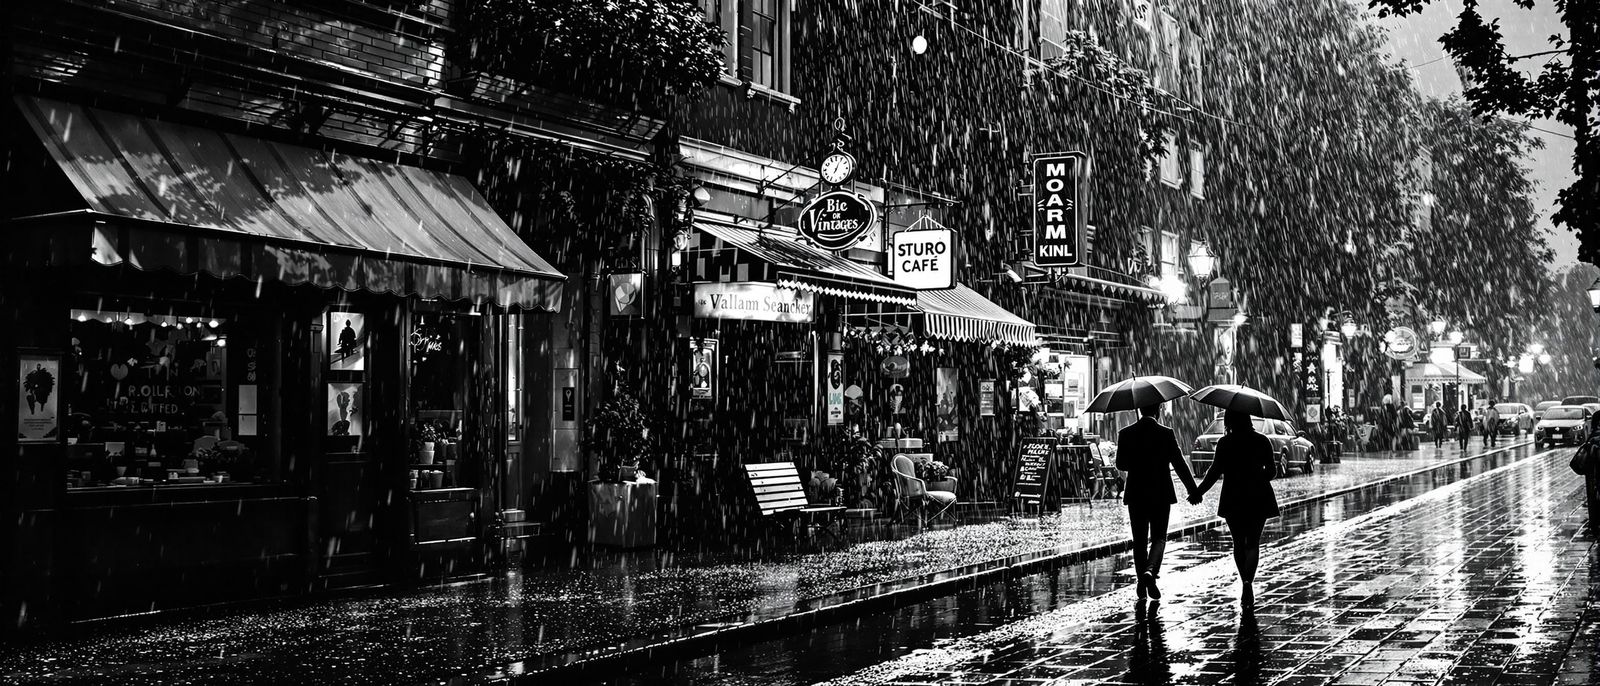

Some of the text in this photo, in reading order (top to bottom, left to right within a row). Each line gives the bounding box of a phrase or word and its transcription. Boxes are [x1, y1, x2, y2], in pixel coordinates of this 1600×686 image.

[1045, 163, 1067, 239] MOARM
[898, 241, 946, 257] STURO
[1040, 244, 1073, 257] KINL
[902, 255, 939, 273] CAFÉ
